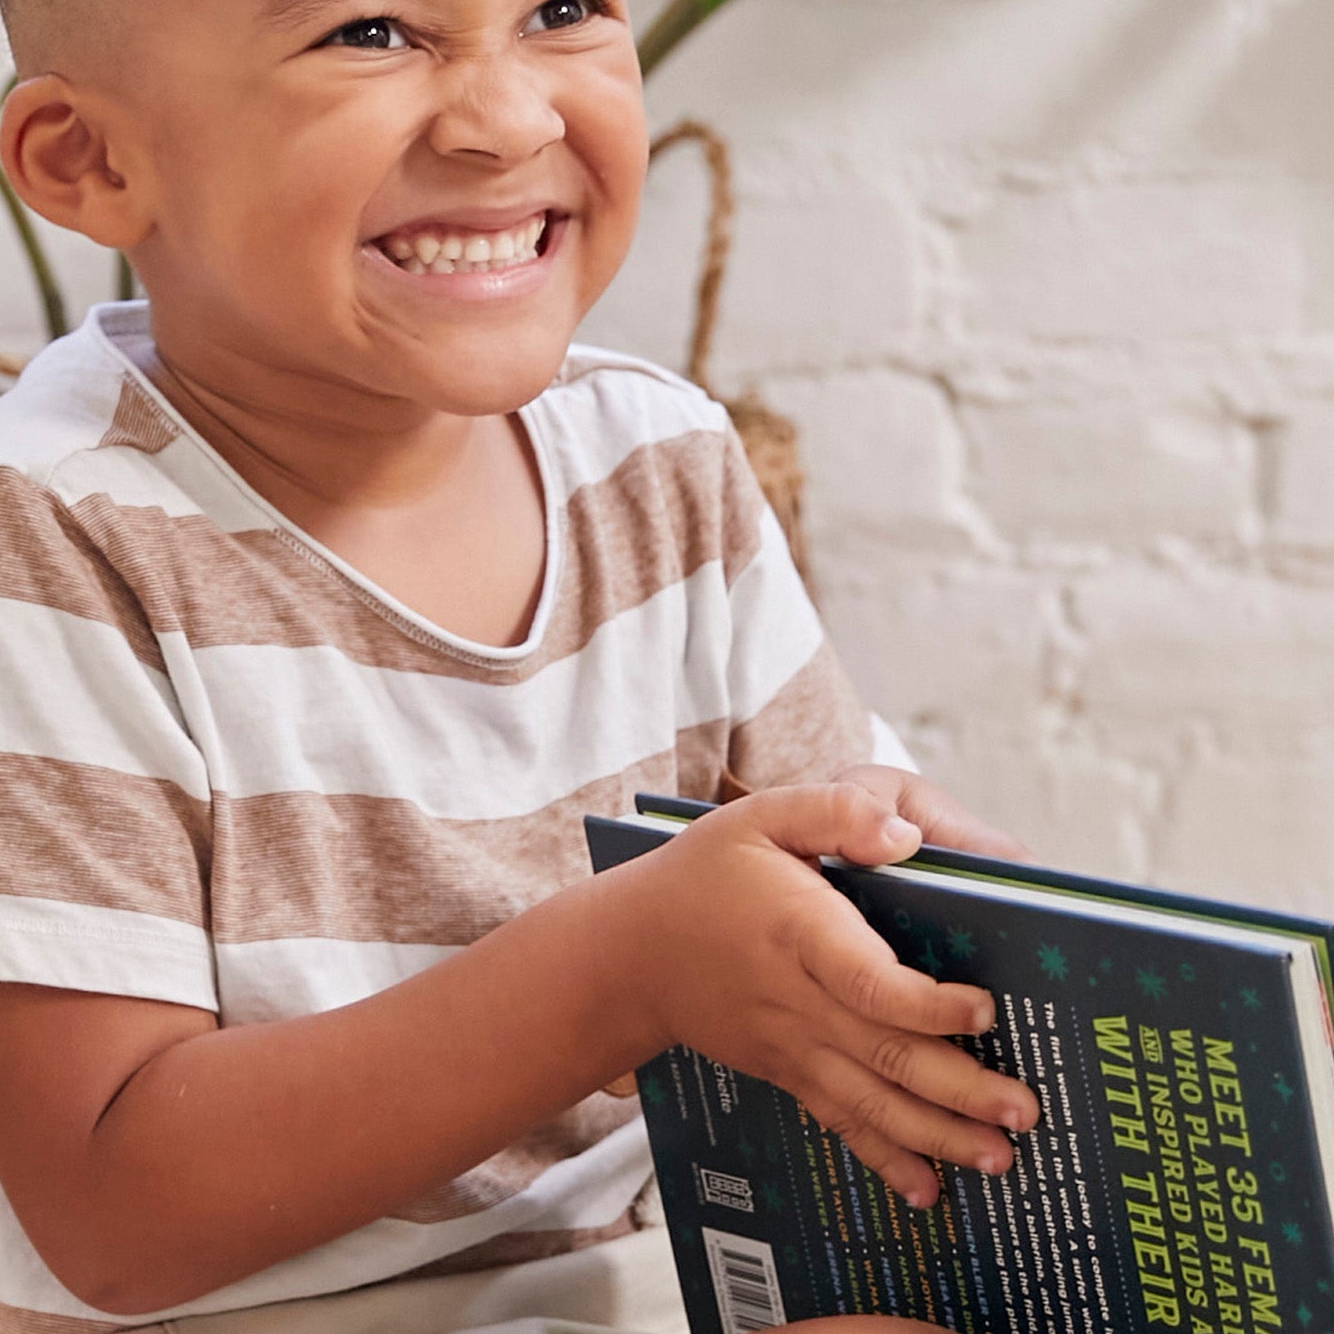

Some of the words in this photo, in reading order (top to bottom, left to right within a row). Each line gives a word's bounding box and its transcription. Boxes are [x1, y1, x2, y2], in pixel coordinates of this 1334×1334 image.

[1022, 996, 1036, 1026] one
[1042, 1000, 1057, 1030] The
[991, 1037, 1003, 1057] an
[1028, 1031, 1046, 1078] tennis
[1048, 1035, 1064, 1066] first
[1142, 1025, 1160, 1063] AND
[1167, 1025, 1204, 1106] WHO
[712, 1062, 734, 1114] chette
[1055, 1072, 1073, 1127] woman
[1090, 1009, 1151, 1155] WITH
[1201, 1035, 1252, 1157] MEET
[1037, 1083, 1056, 1131] player
[803, 1139, 817, 1167] JEN
[1028, 1128, 1046, 1180] landed
[1048, 1136, 1060, 1151] in
[1066, 1131, 1083, 1174] horse
[1145, 1072, 1194, 1224] INSPIRED
[820, 1136, 838, 1185] MYERS
[830, 1188, 849, 1243] TAYLOR
[1038, 1182, 1047, 1191] a
[1052, 1156, 1065, 1181] the
[1182, 1112, 1229, 1245] PLAYED
[809, 1170, 829, 1227] WELTER
[1022, 1199, 1031, 1210] a
[1058, 1186, 1075, 1234] world.
[1074, 1178, 1093, 1228] jockey
[1224, 1165, 1264, 1226] 35
[838, 1136, 854, 1182] ONDA
[848, 1186, 866, 1243] ROUSEY
[863, 1257, 880, 1306] WILMA
[864, 1181, 884, 1241] PATRICK
[880, 1256, 897, 1307] MEGAN
[954, 1176, 977, 1254] GRETCHEN
[969, 1256, 989, 1315] BLEILER
[1067, 1239, 1078, 1252] A
[1085, 1233, 1097, 1250] to
[989, 1226, 1006, 1267] using
[998, 1269, 1013, 1304] their
[1013, 1249, 1024, 1268] on
[1024, 1214, 1046, 1283] ballerina,
[1039, 1194, 1069, 1298] death-defying
[1119, 1166, 1182, 1330] THEIR
[1173, 1230, 1209, 1308] KIDS
[897, 1254, 915, 1305] NANCY
[908, 1221, 925, 1273] JACKIE
[919, 1276, 936, 1322] JOYNE
[936, 1270, 950, 1302] LISA
[951, 1259, 969, 1306] SASHA
[1018, 1271, 1031, 1295] the
[1071, 1257, 1088, 1301] surfer
[1088, 1255, 1111, 1321] compete
[1021, 1298, 1039, 1334] field,
[1039, 1286, 1053, 1315] and
